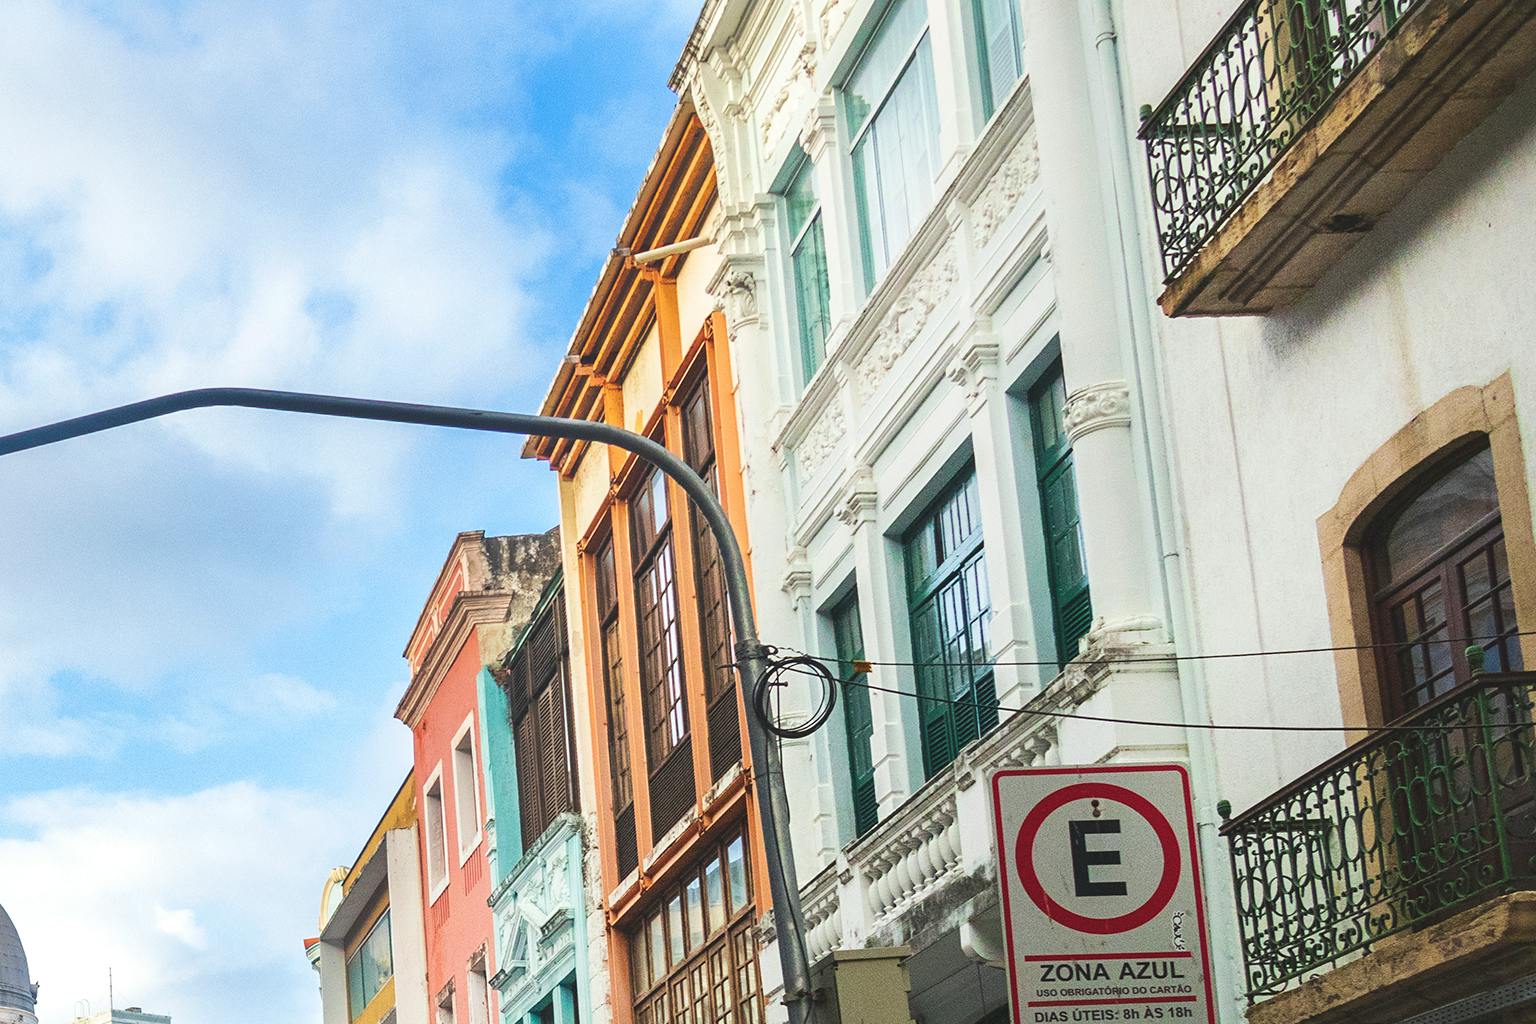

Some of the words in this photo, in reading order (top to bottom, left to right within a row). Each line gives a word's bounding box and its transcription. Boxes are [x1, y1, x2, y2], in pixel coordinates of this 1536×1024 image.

[1068, 819, 1128, 897] E
[1040, 963, 1110, 982] ZONA
[1119, 961, 1184, 980] AZUL
[1036, 989, 1057, 997] USO
[1060, 985, 1128, 996] OBRIGATÓRIO
[1133, 986, 1147, 994] DO
[1149, 984, 1192, 994] CARTÃO
[1035, 1012, 1068, 1023] DIAS
[1073, 1008, 1119, 1021] ÚTEIS:
[1123, 1009, 1139, 1020] 8h
[1144, 1006, 1163, 1019] ÀS
[1168, 1007, 1192, 1018] 18h
